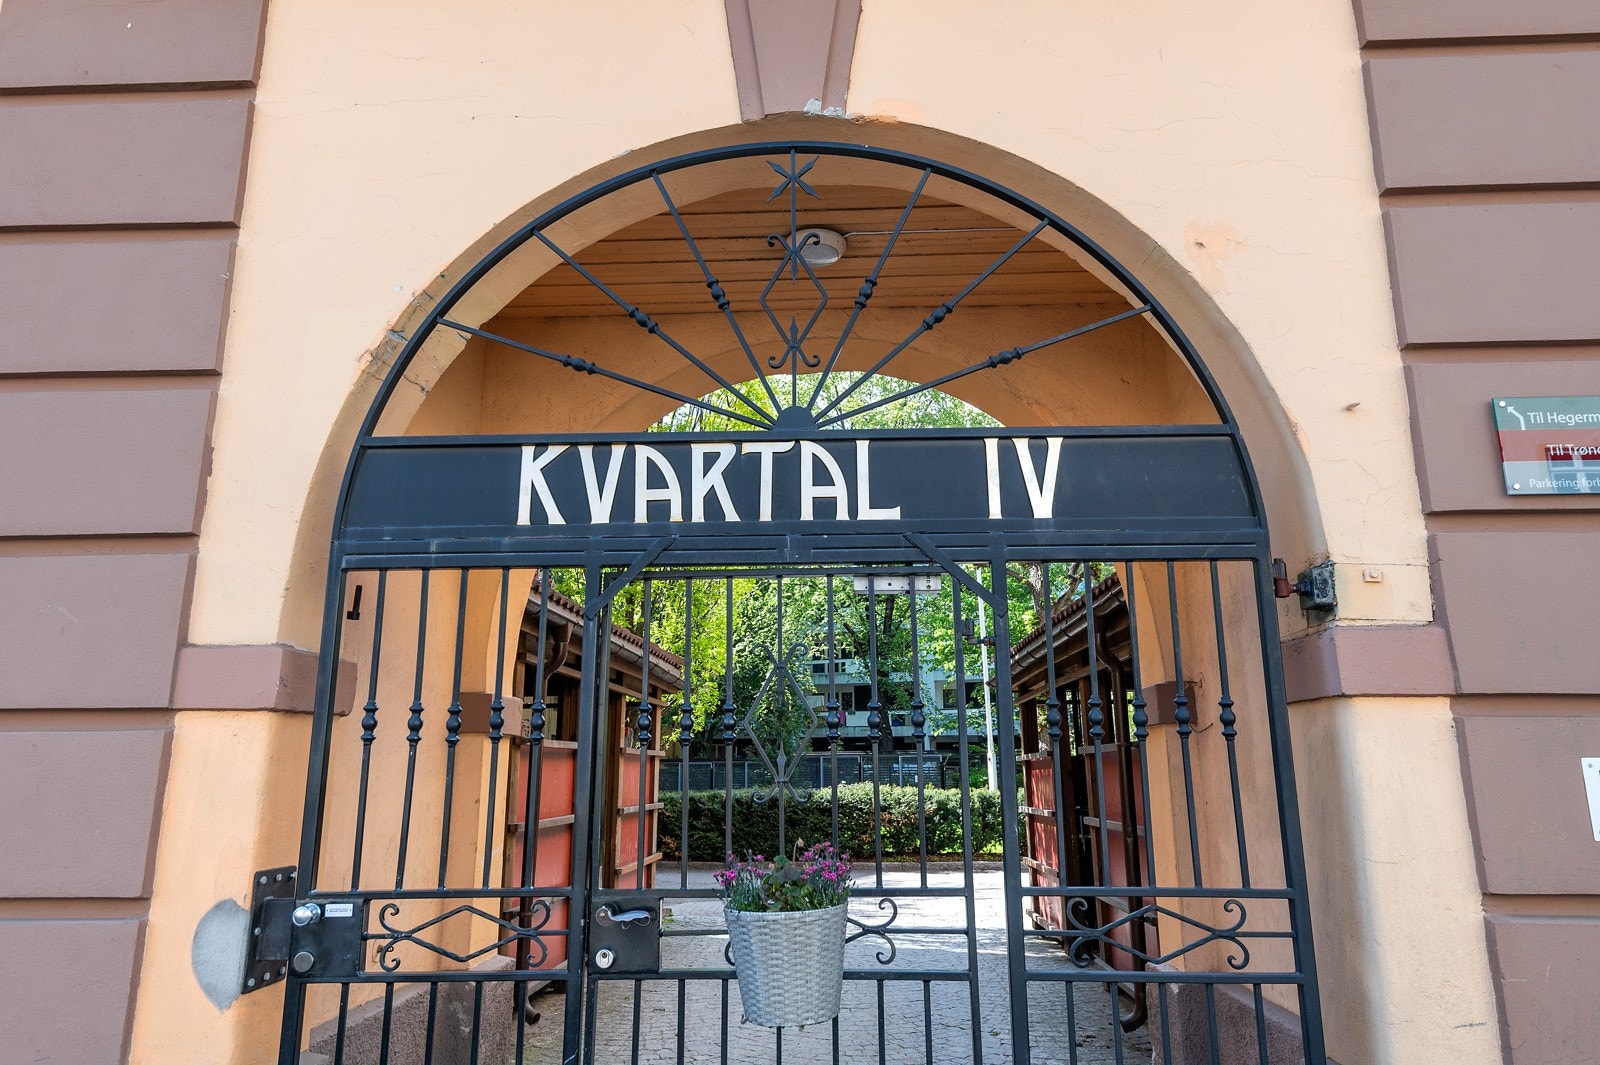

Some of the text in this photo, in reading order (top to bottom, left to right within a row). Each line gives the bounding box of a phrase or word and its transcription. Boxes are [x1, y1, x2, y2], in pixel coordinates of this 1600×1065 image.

[1526, 411, 1544, 424] Til
[1546, 444, 1564, 456] Til
[516, 436, 1064, 526] KVARTAL IV
[1528, 477, 1580, 490] Parkering
